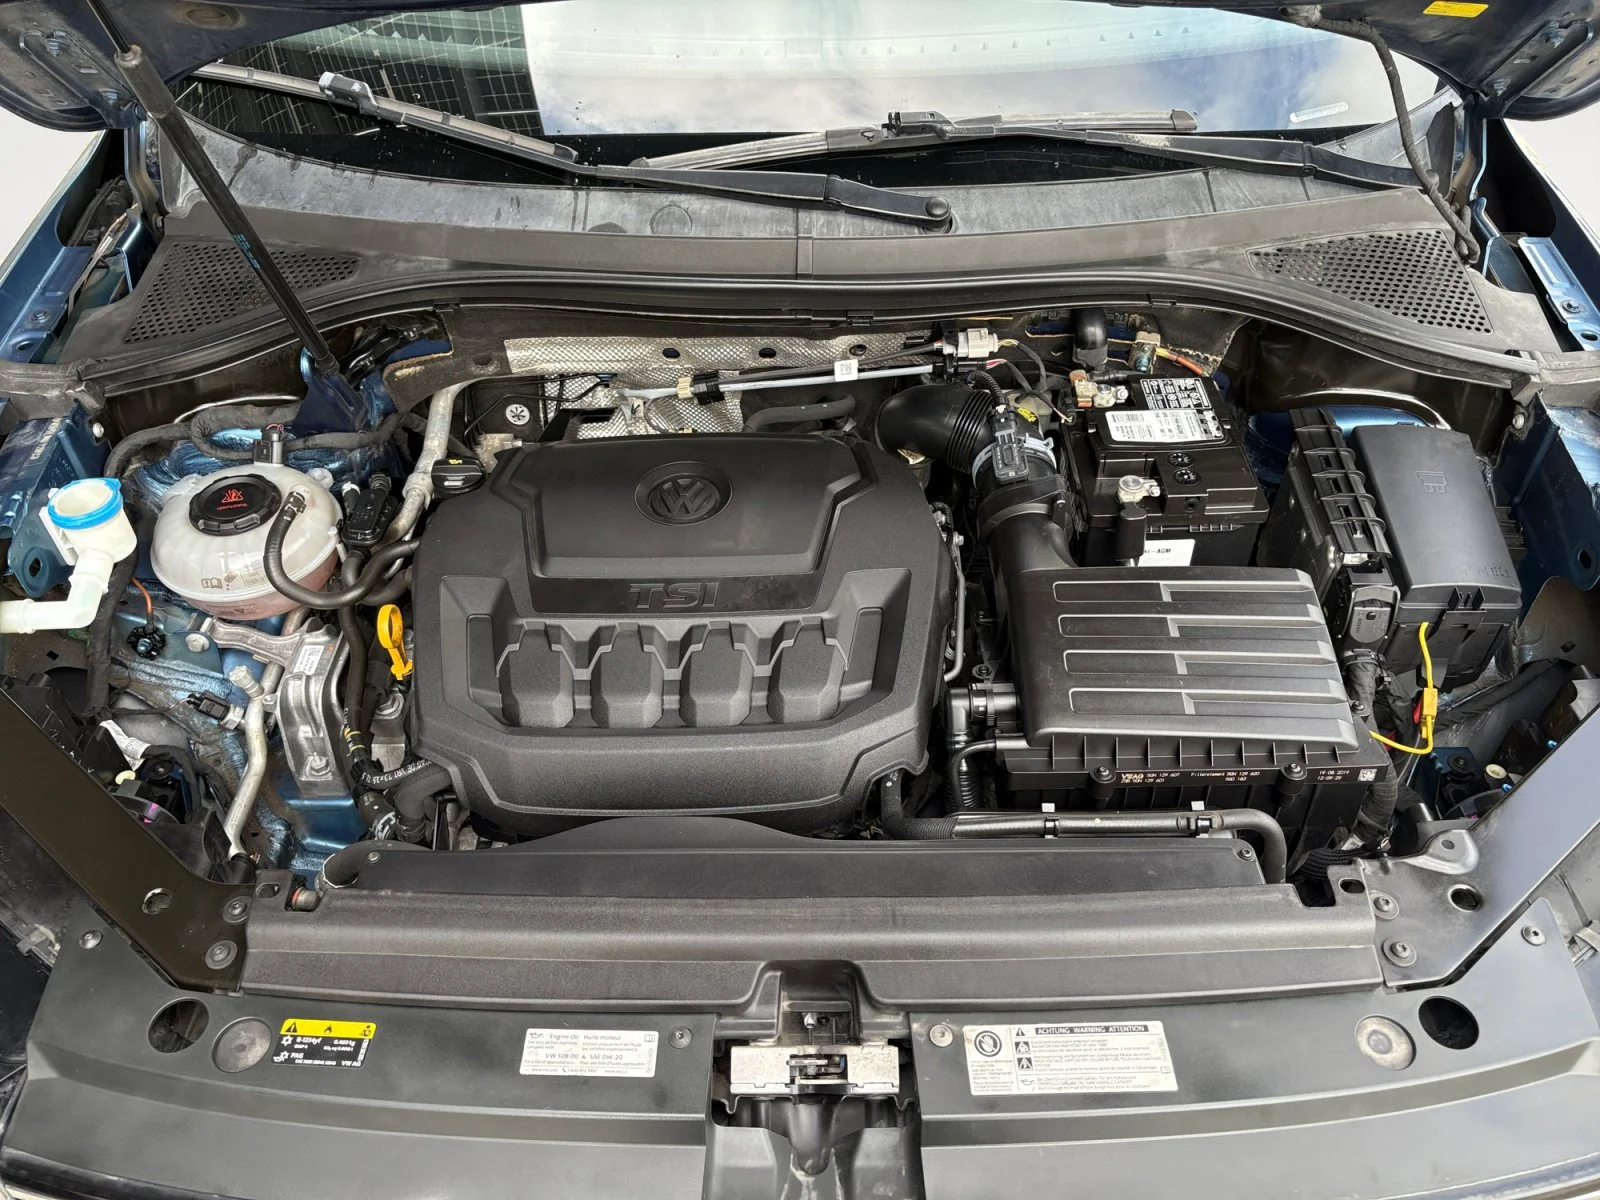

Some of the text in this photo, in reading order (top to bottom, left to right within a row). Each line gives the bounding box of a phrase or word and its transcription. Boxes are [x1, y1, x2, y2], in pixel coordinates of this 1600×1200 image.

[629, 582, 719, 608] TSI
[549, 1033, 569, 1041] Engine
[584, 1033, 599, 1041] Huile
